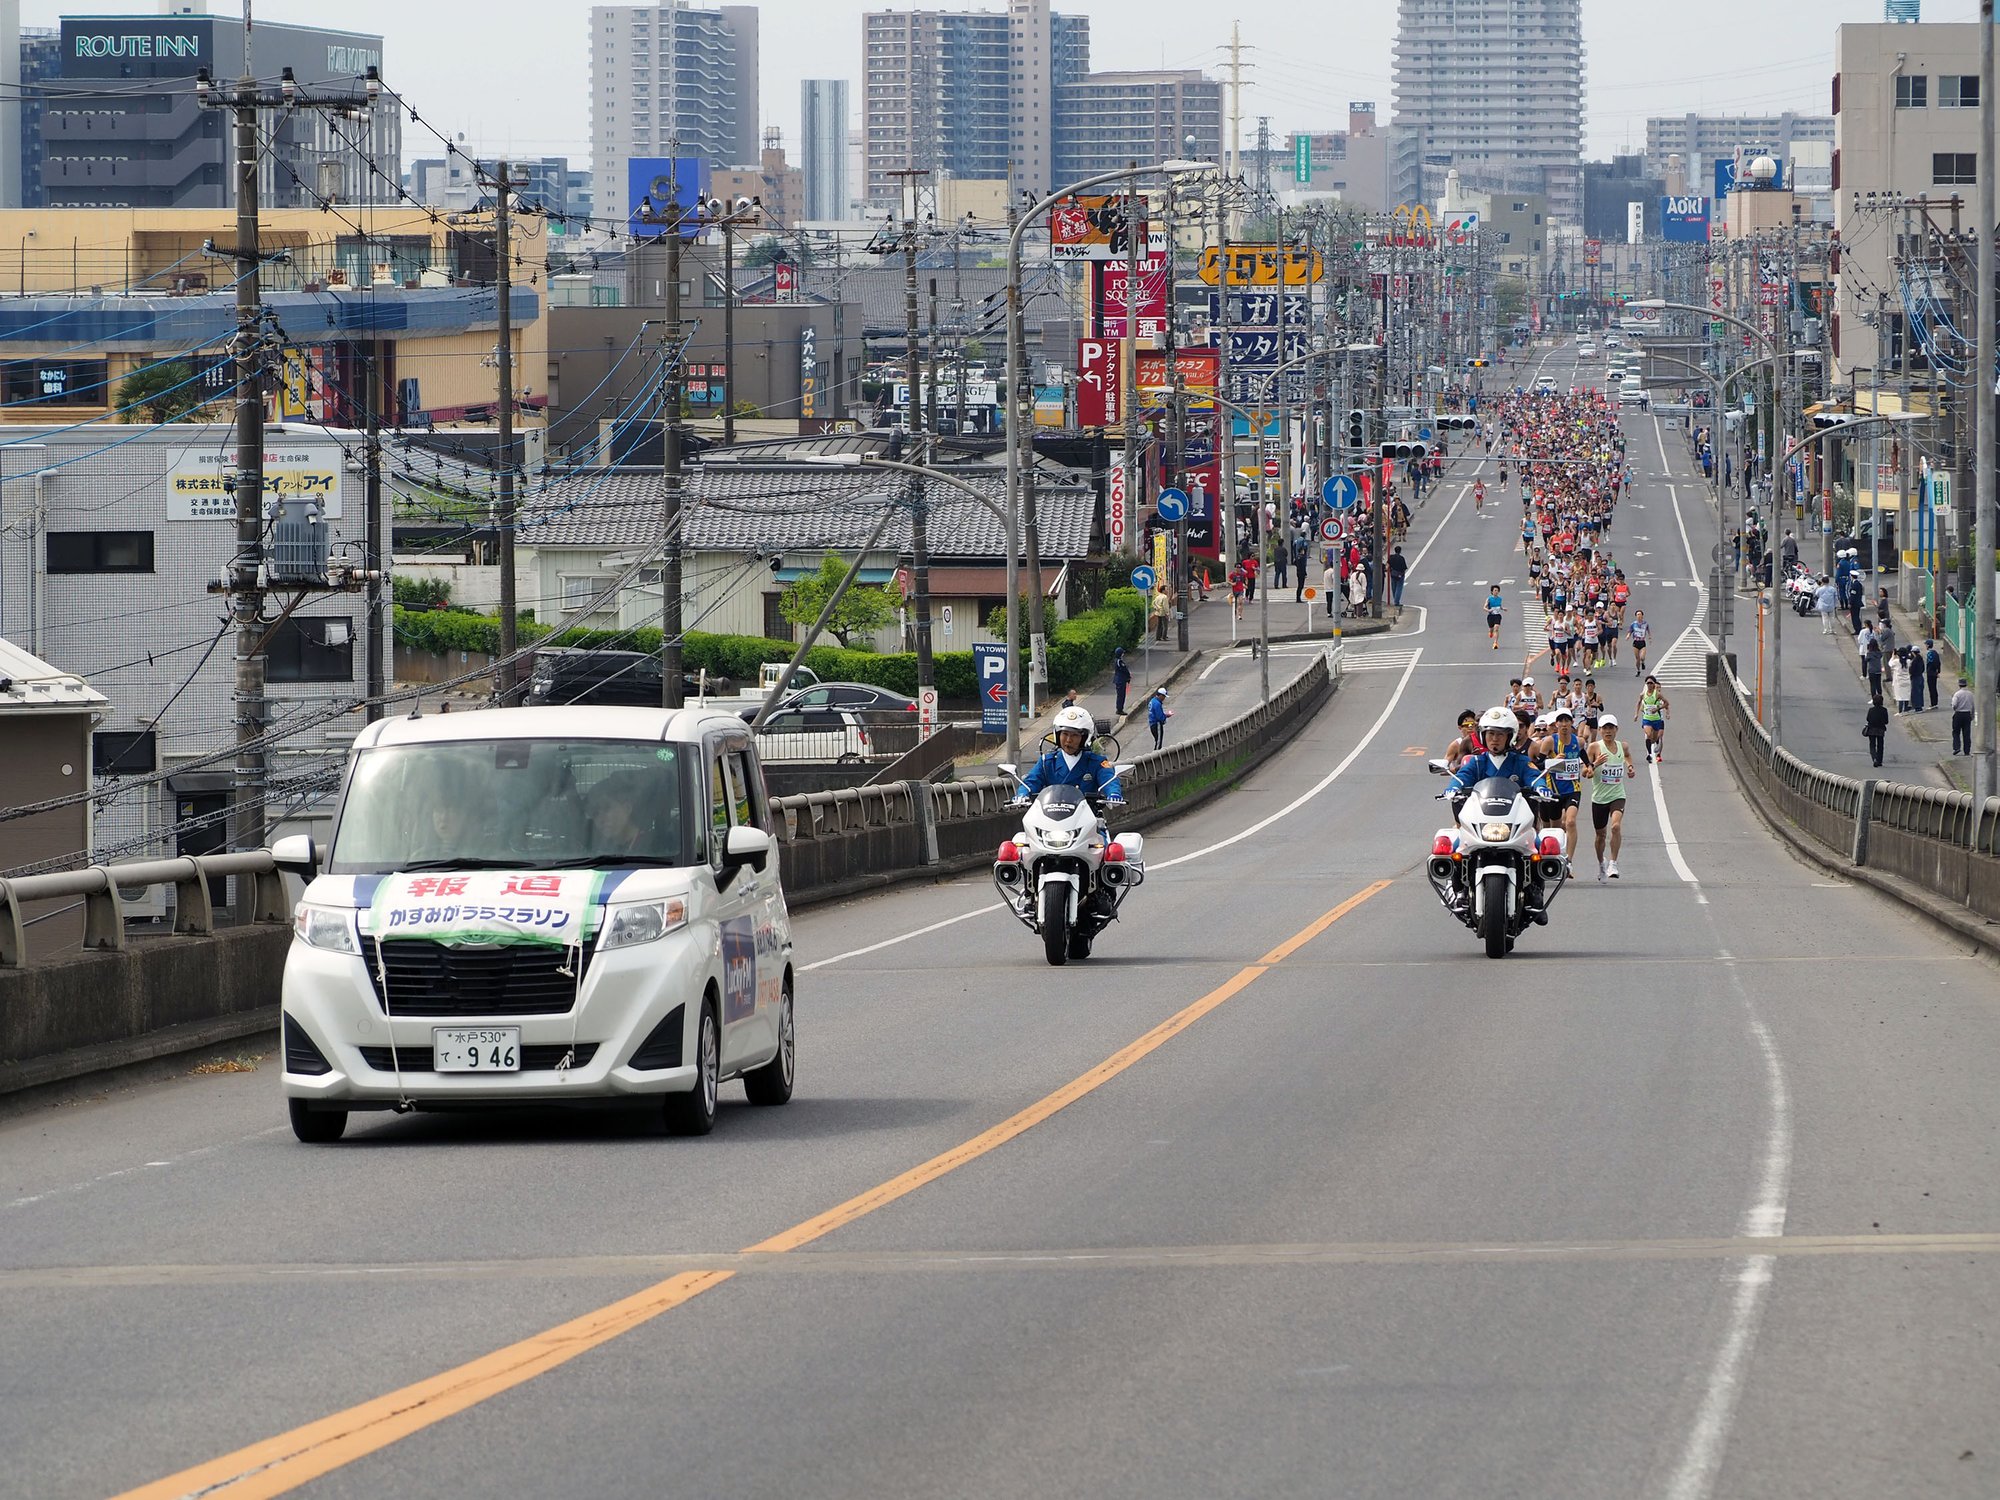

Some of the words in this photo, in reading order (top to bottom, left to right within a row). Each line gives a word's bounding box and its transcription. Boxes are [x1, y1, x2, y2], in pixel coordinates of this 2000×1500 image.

[76, 35, 151, 57] ROUTE
[155, 35, 198, 57] INN
[1666, 197, 1703, 214] AOKI
[1103, 259, 1160, 272] ASMI
[1112, 279, 1144, 290] FOD
[1105, 290, 1151, 302] SQURE
[1138, 320, 1159, 337] 酒
[1082, 342, 1103, 369] P
[1140, 360, 1205, 370] スポークラブ
[39, 369, 67, 382] なかにし
[43, 382, 63, 394] 歯科
[1105, 342, 1117, 423] ピアタウン駐車場
[1158, 418, 1208, 433] Sria
[198, 455, 230, 464] 損害保険
[278, 454, 310, 463] 生命保険
[175, 478, 221, 490] 株式会社
[190, 498, 231, 507] 交通事故
[190, 507, 237, 516] 生命保険証券
[1186, 527, 1208, 539] Hut
[1325, 524, 1339, 535] 40
[975, 645, 986, 653] PIA
[985, 646, 1007, 654] TOWN
[983, 655, 1006, 680] P
[1608, 768, 1624, 777] 1417
[1042, 802, 1076, 810] POLICE
[389, 904, 571, 929] かすみがうらマラソン
[440, 1051, 450, 1063] て
